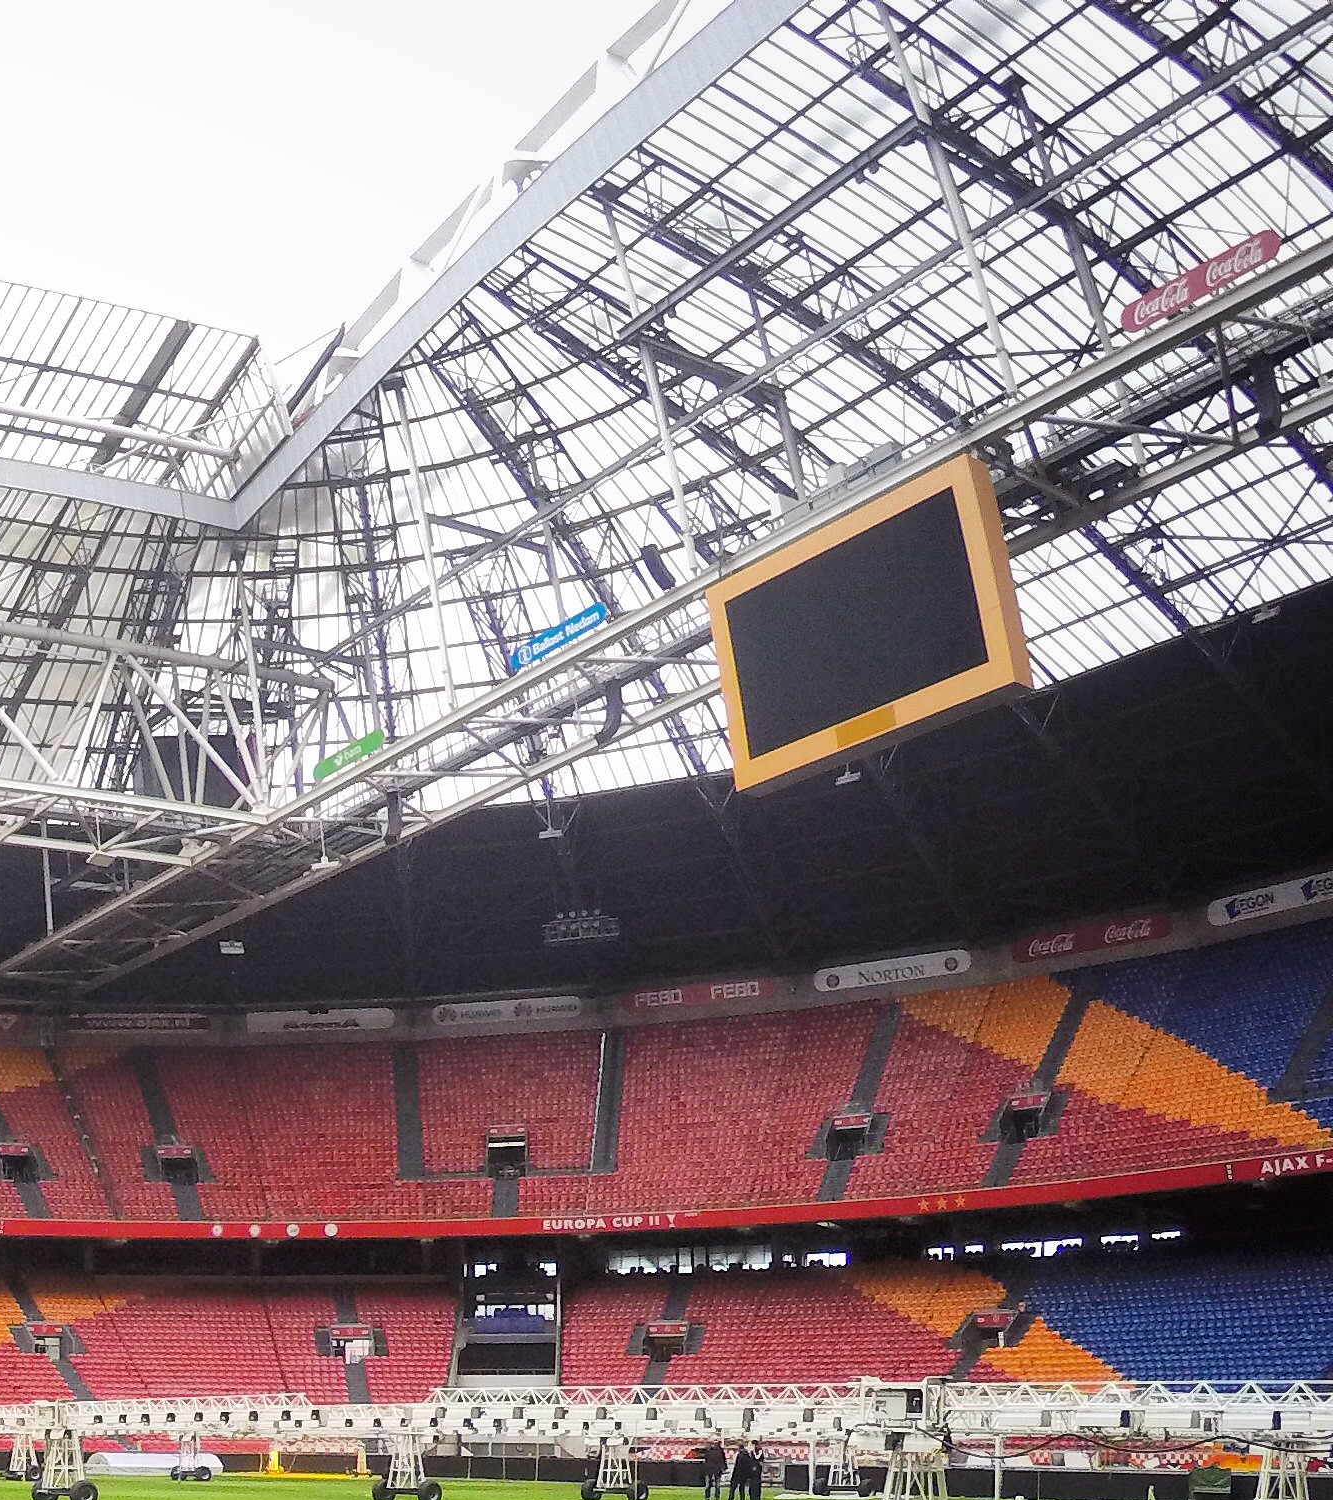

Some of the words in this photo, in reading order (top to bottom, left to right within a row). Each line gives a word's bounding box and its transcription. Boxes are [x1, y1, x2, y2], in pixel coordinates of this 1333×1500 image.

[858, 964, 925, 985] NORTON
[1260, 1155, 1311, 1176] AJAX
[542, 1217, 606, 1231] EUROPA
[612, 1215, 644, 1229] CUP
[648, 1215, 661, 1227] II
